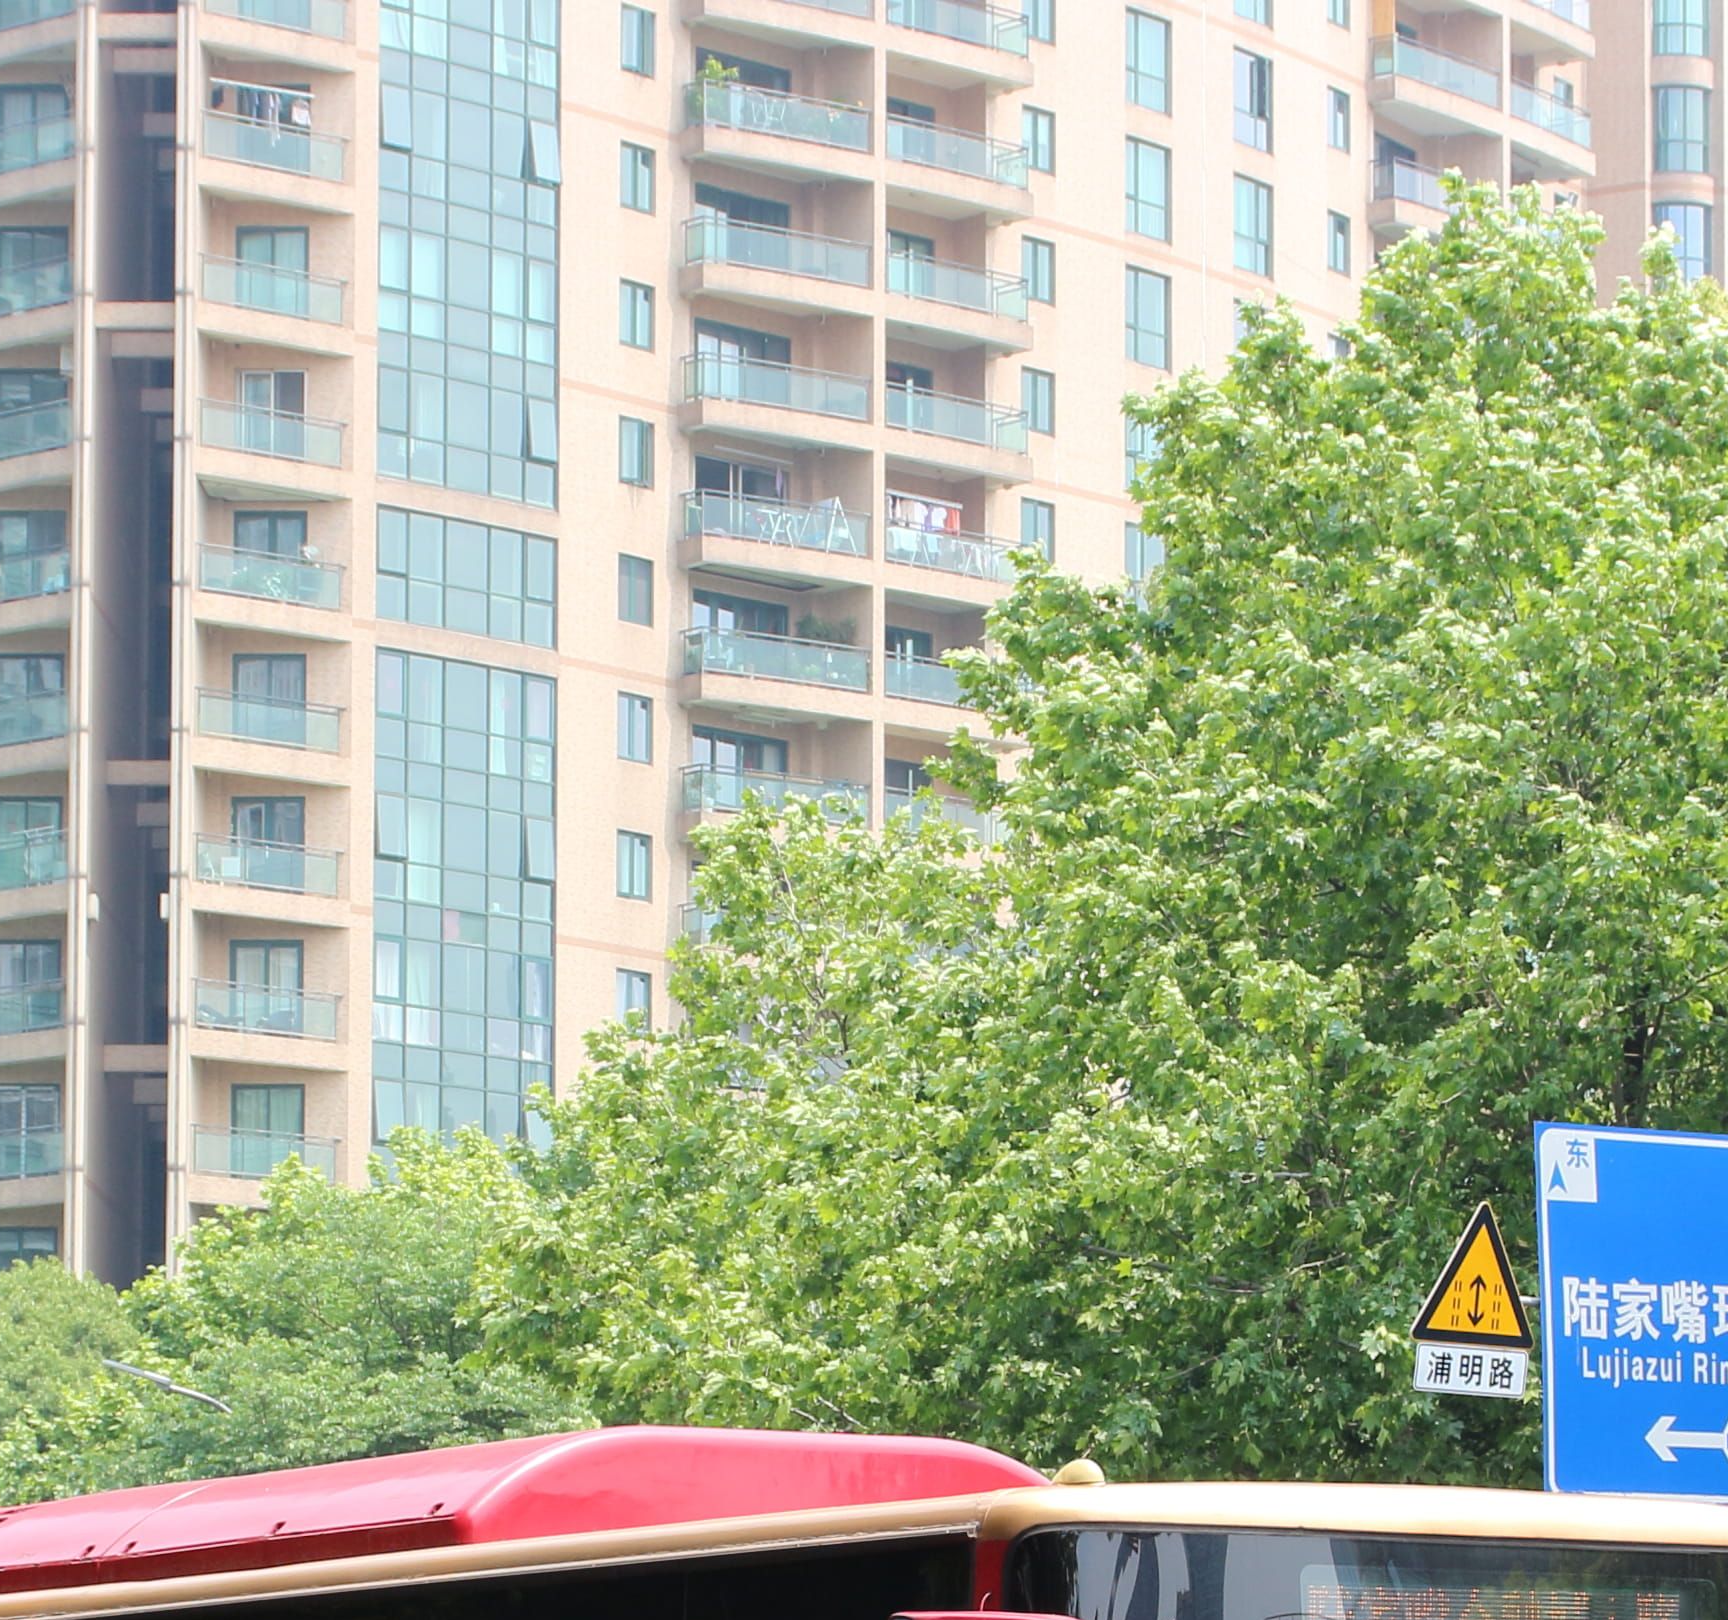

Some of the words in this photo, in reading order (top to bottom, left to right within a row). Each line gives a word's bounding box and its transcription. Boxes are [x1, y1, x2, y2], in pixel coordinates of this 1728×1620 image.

[1565, 1138, 1590, 1169] 东
[1427, 1352, 1515, 1390] 浦明路
[1582, 1347, 1683, 1389] Lujiazui
